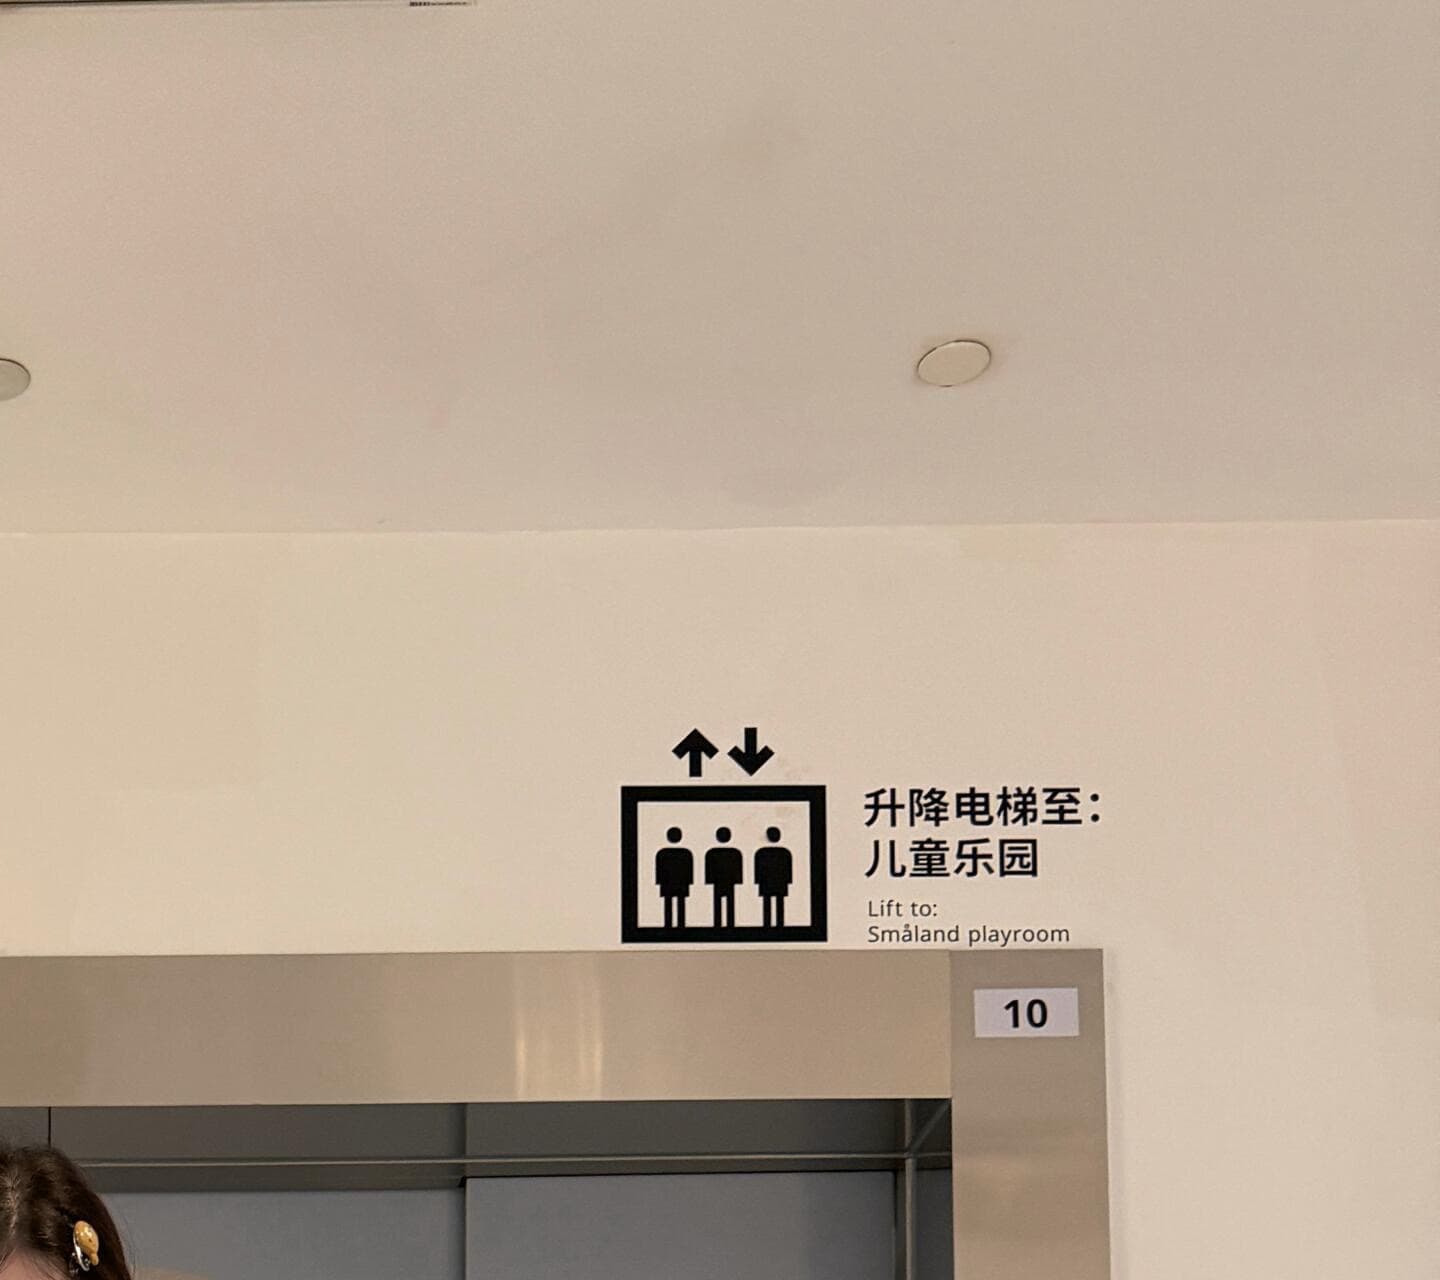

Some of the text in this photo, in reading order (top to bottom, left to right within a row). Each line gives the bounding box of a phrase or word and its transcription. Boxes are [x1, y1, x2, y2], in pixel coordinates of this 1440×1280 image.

[864, 837, 1039, 878] 儿童乐园
[867, 899, 938, 917] Lift to:
[867, 924, 1071, 947] Småland playroom
[1003, 999, 1048, 1029] 10
